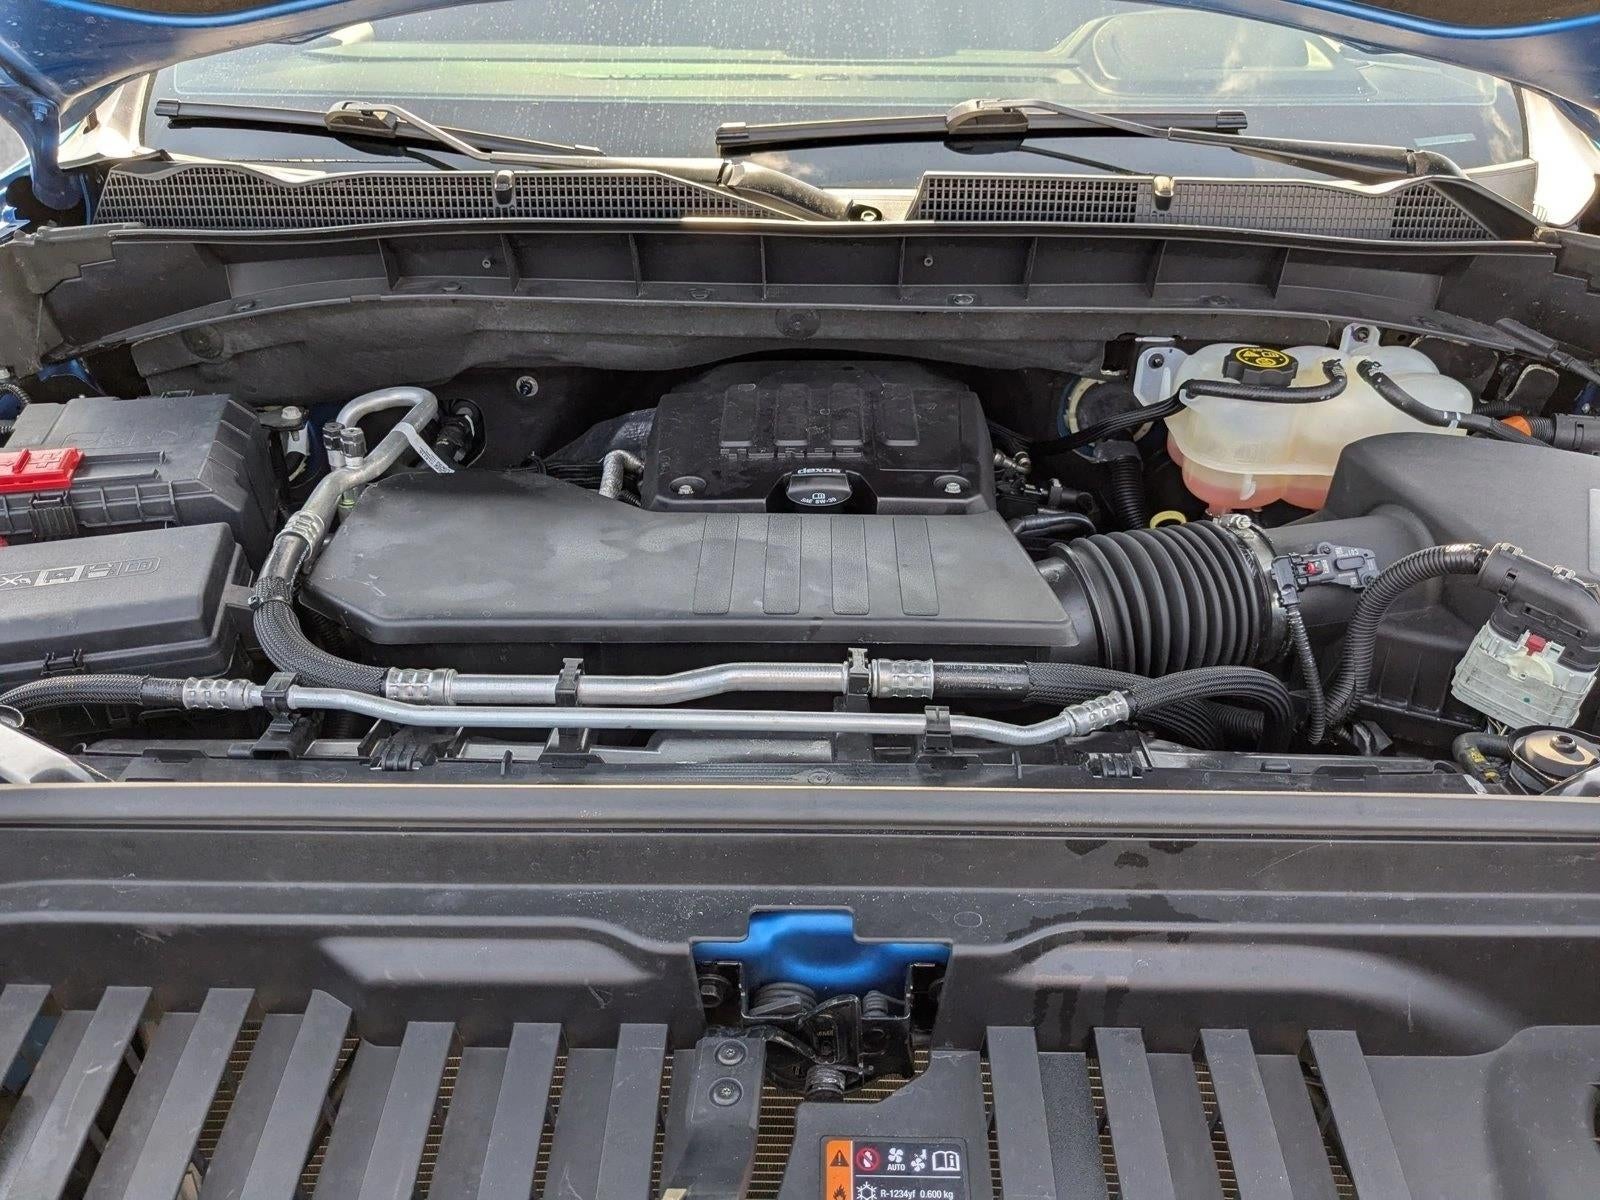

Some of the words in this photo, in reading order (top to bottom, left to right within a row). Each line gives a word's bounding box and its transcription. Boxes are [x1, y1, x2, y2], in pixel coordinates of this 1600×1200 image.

[887, 1163, 906, 1171] AUTO
[880, 1189, 916, 1199] R-1234yf
[920, 1190, 942, 1198] 0.600
[943, 1190, 954, 1200] kg
